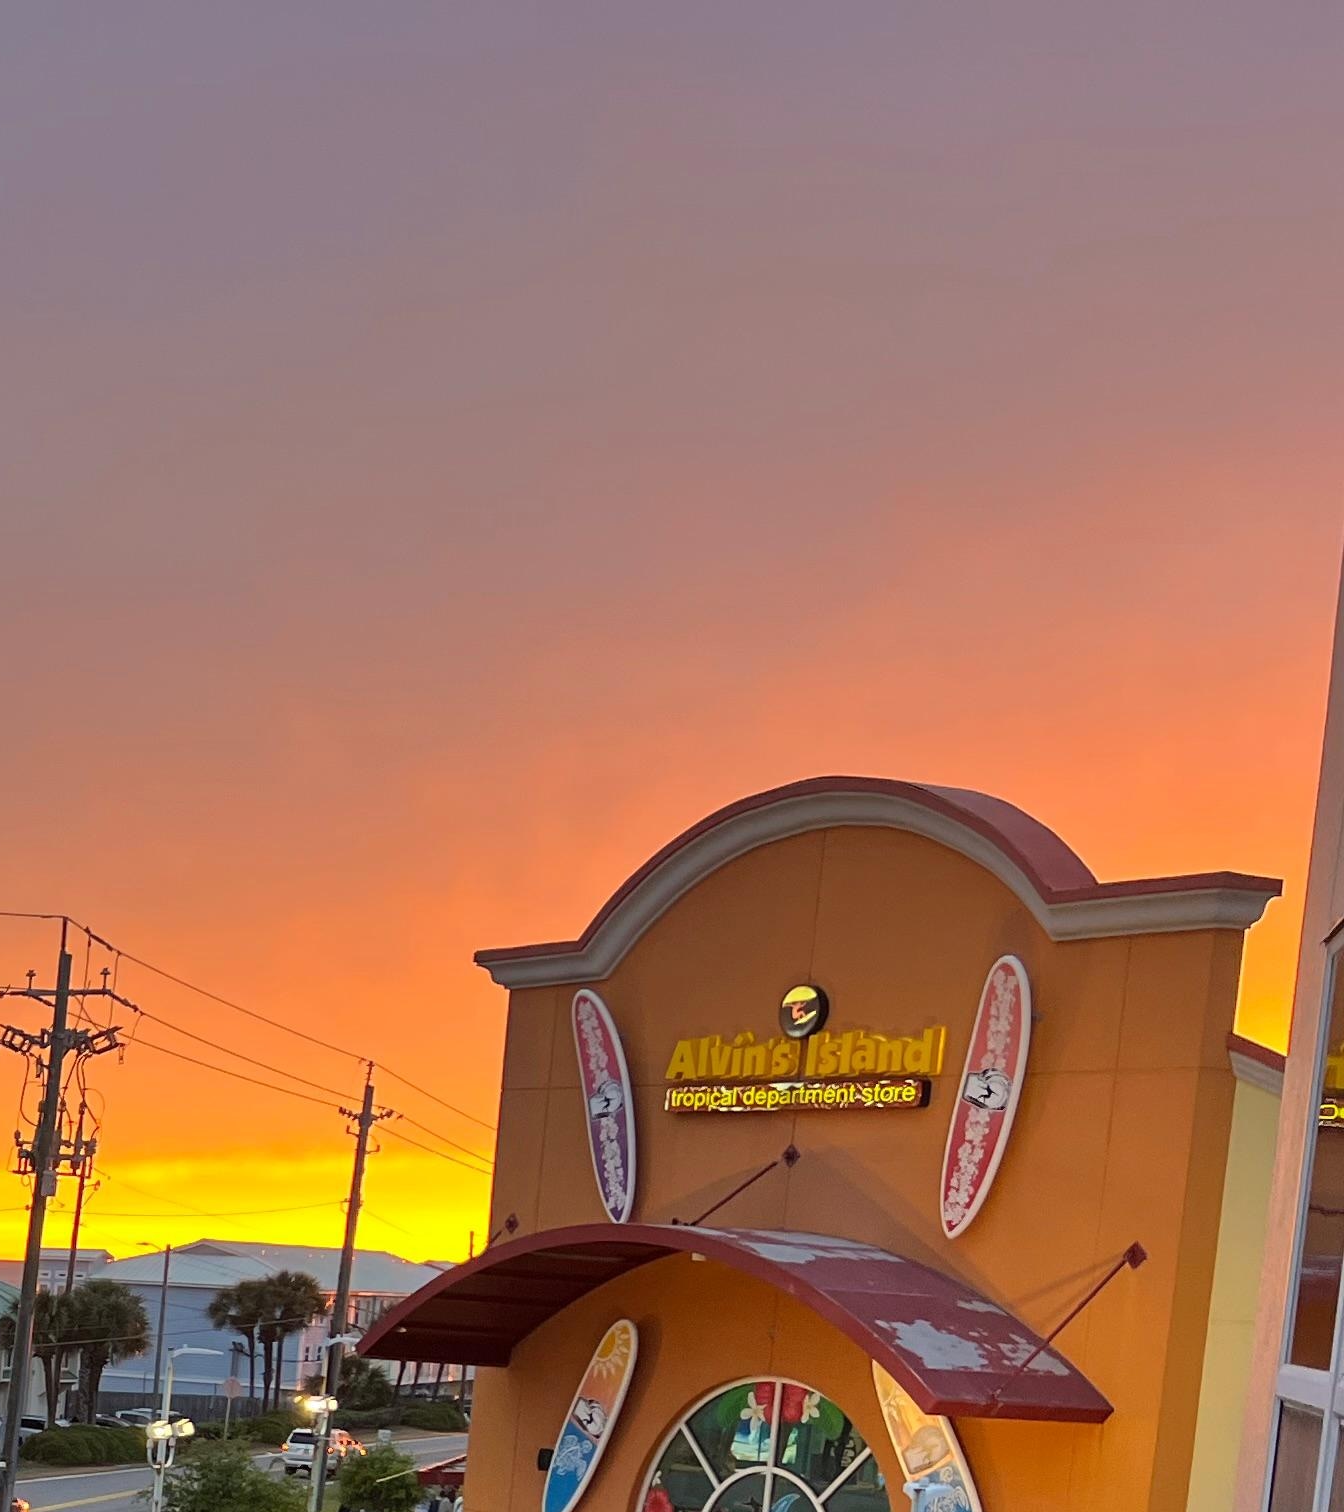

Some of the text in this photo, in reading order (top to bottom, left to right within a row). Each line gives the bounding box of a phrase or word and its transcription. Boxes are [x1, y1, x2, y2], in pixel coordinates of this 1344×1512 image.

[665, 1026, 946, 1079] Alvin's Island
[671, 1083, 917, 1111] tropical department store
